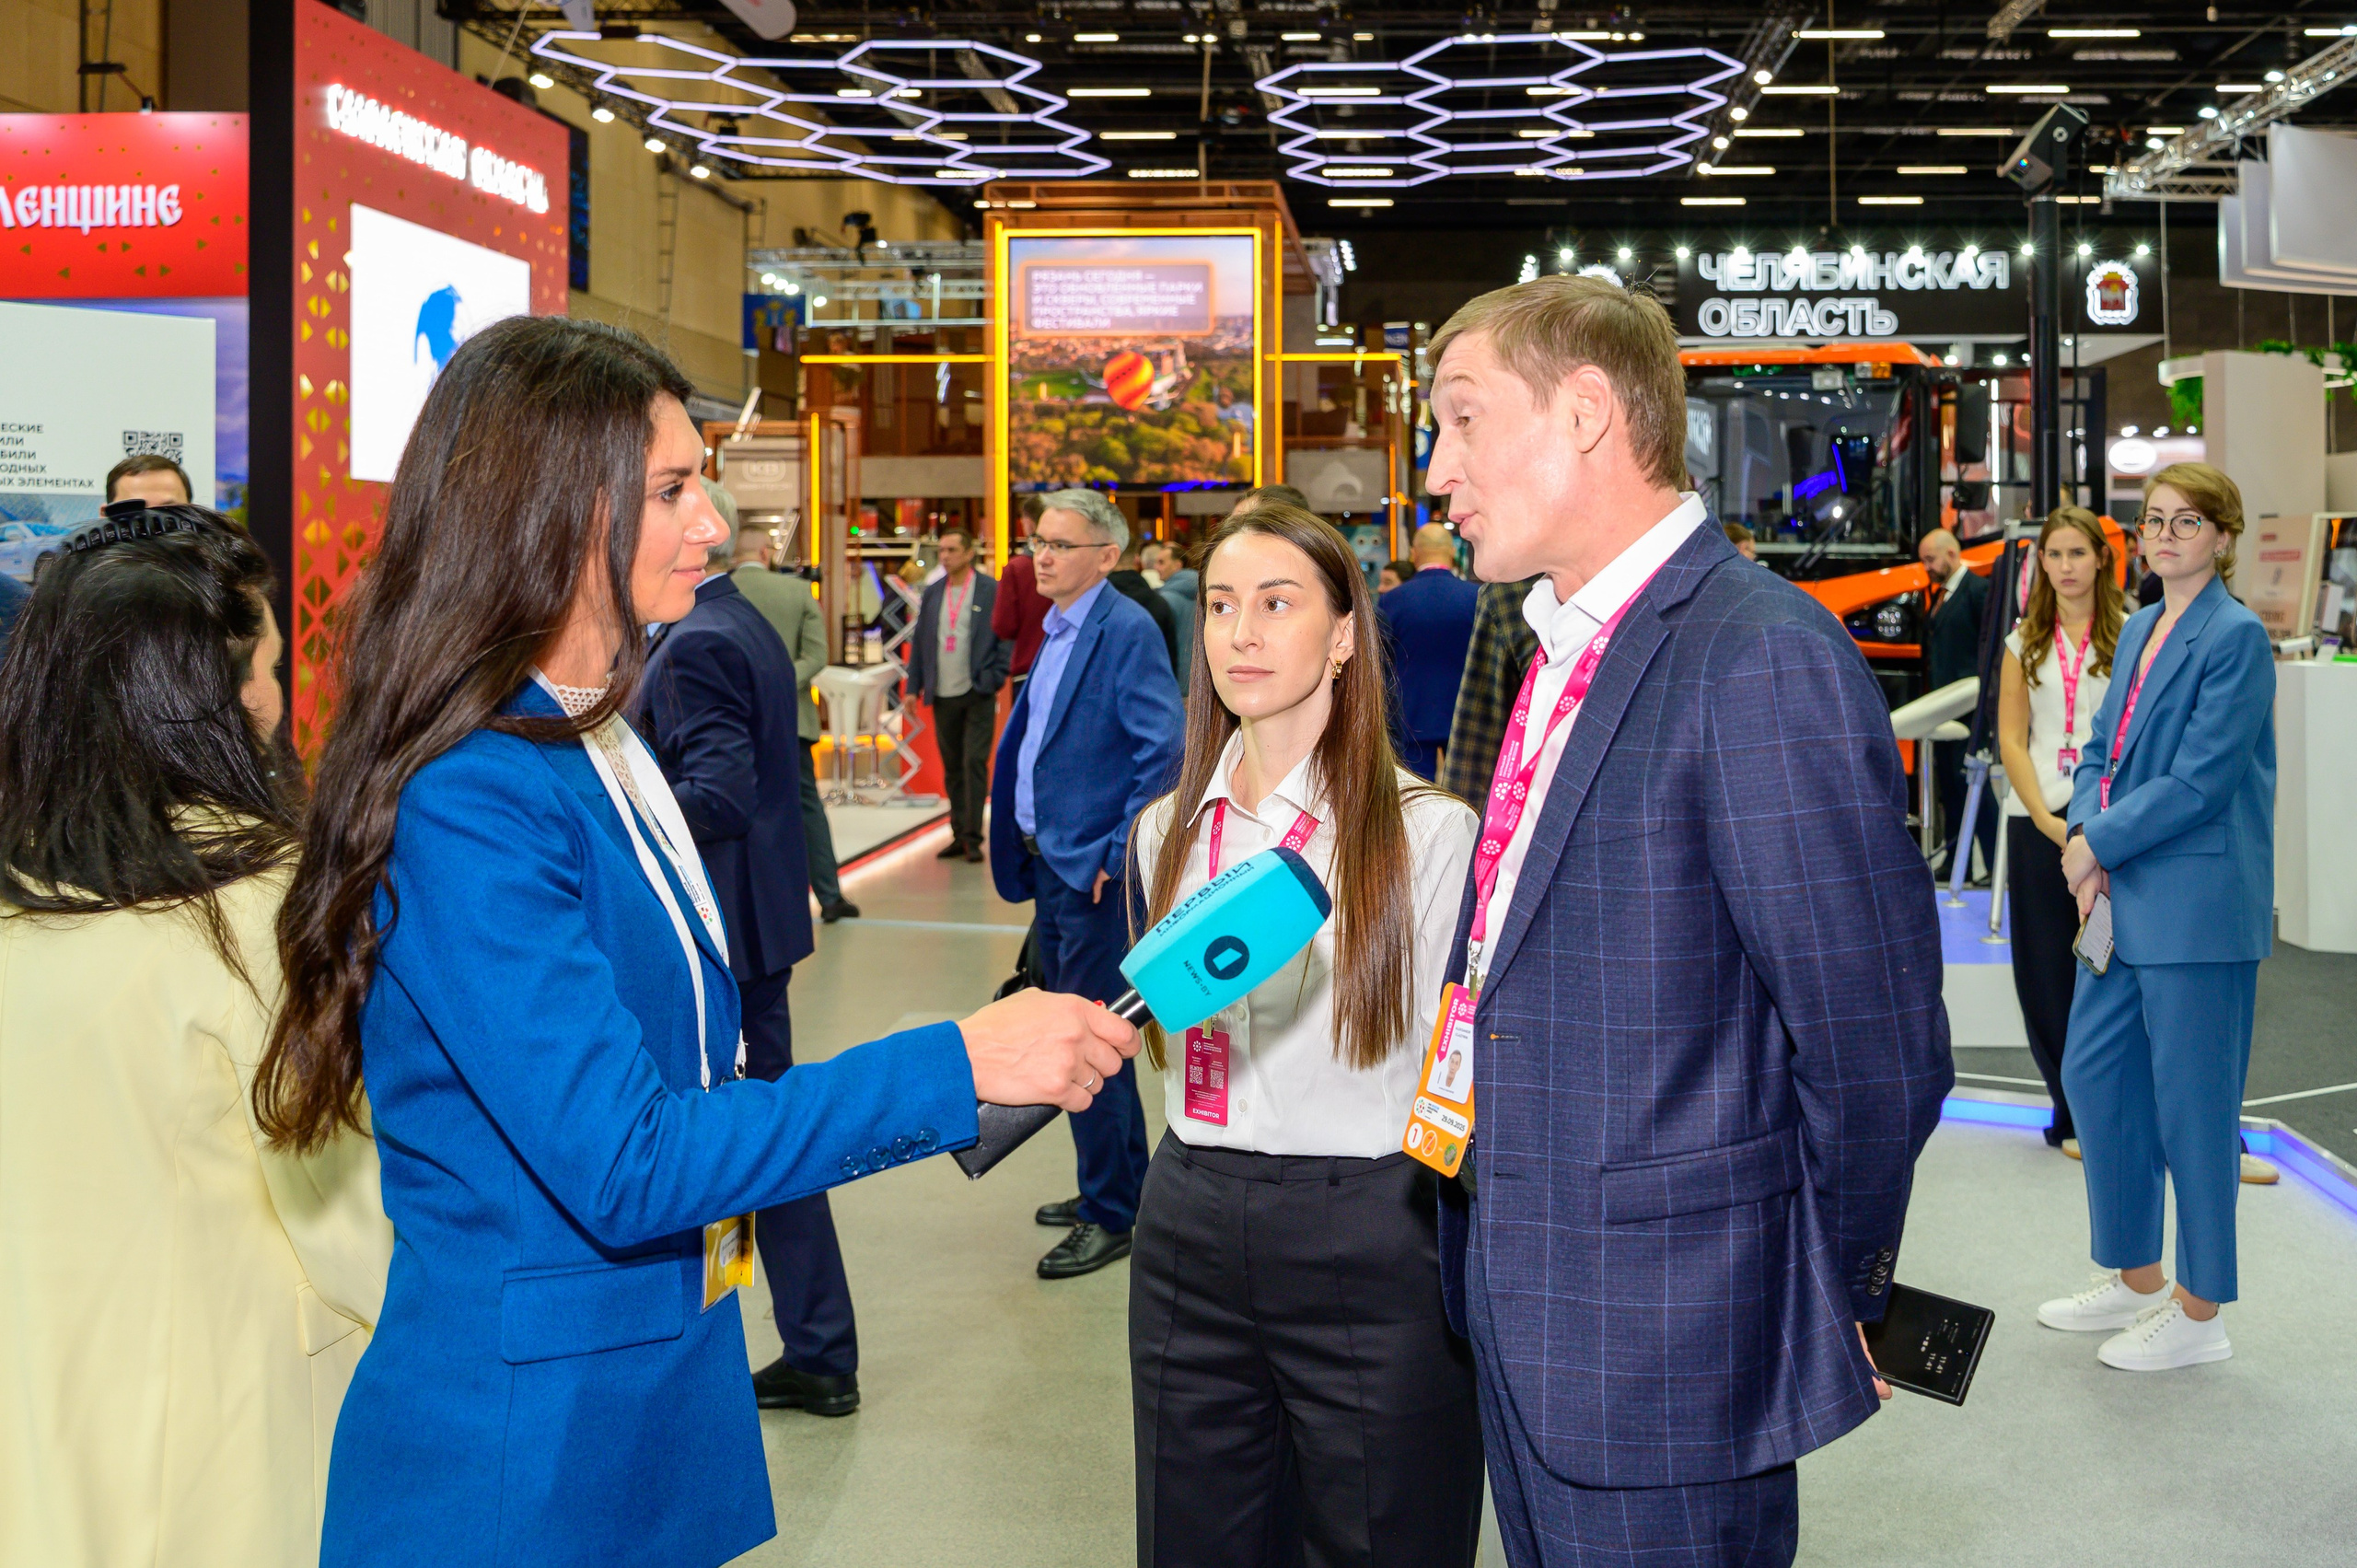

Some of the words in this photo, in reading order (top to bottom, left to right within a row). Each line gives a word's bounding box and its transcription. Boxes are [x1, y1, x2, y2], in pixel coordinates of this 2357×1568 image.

[1698, 251, 2010, 291] ЧЕЛЯБИНСКАЯ
[1698, 297, 1899, 336] ОБЛАСТЬ
[17, 477, 95, 489] ЭЛЕМЕНТАХ
[1155, 862, 1252, 934] ПЕРВЫЙ
[1440, 998, 1459, 1052] EXHIBITOR
[1192, 1108, 1220, 1119] EXHIBITOR
[1441, 1114, 1466, 1132] 29.09.2025
